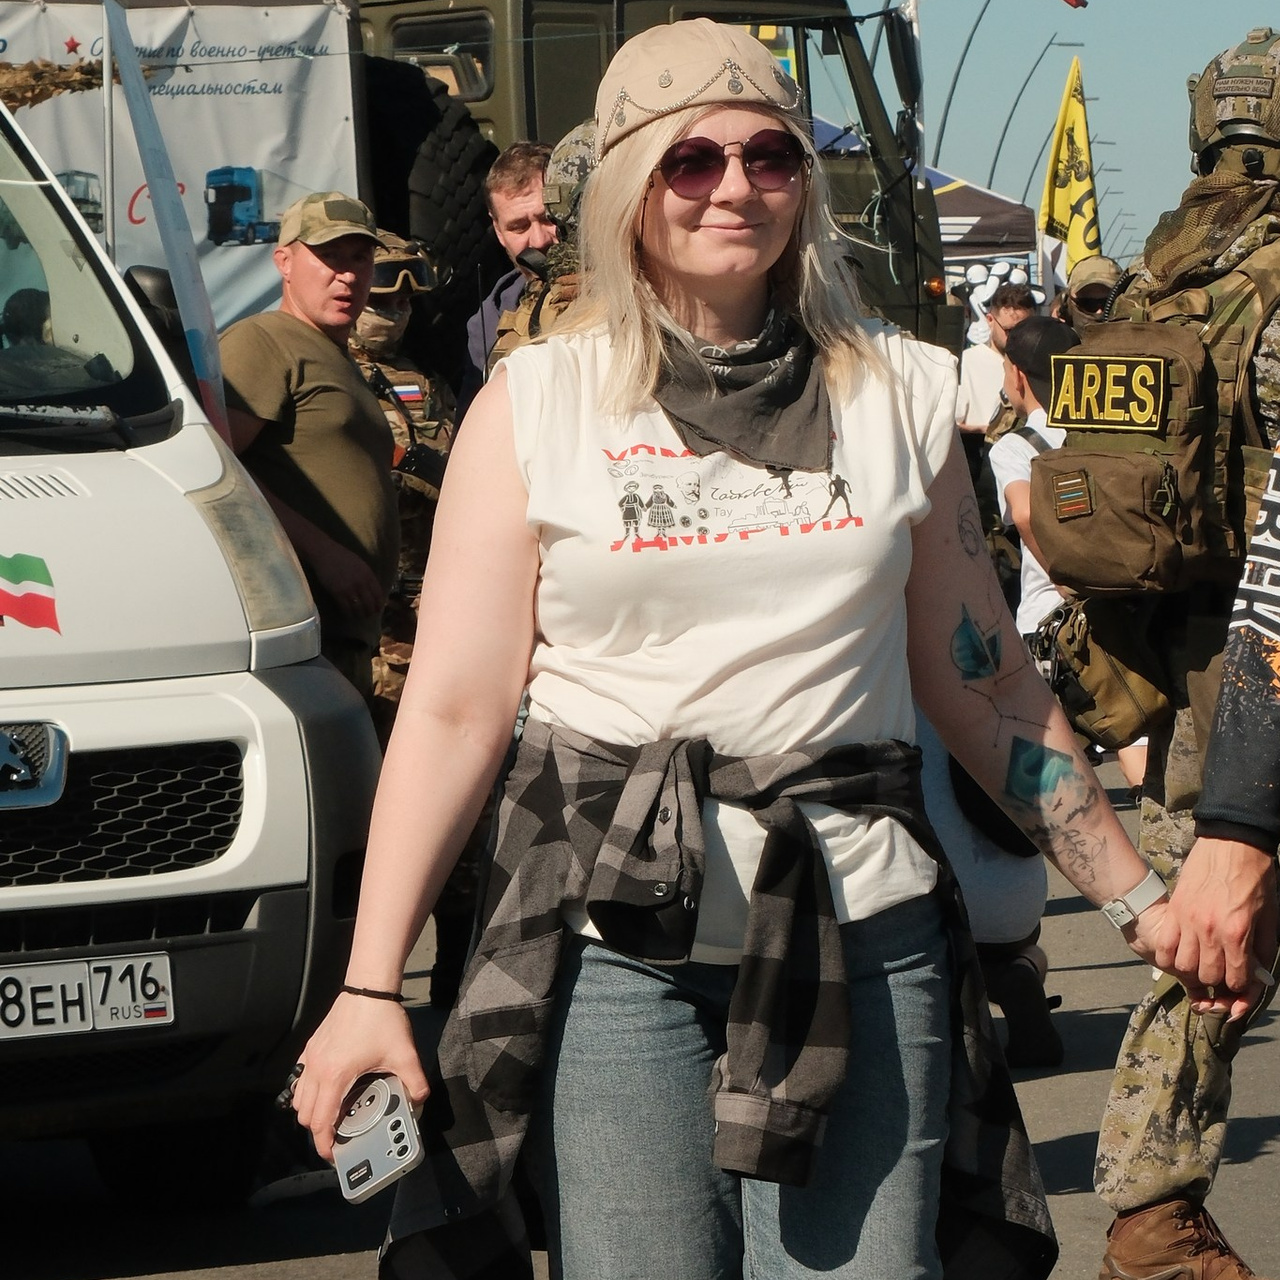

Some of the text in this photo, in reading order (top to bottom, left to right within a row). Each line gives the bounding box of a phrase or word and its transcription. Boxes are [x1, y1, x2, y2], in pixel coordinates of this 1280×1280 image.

[165, 46, 185, 58] по
[150, 81, 283, 99] пециальностям
[1053, 363, 1157, 425] A.R.E.S.
[92, 961, 161, 1006] 716
[110, 1006, 143, 1021] RUS
